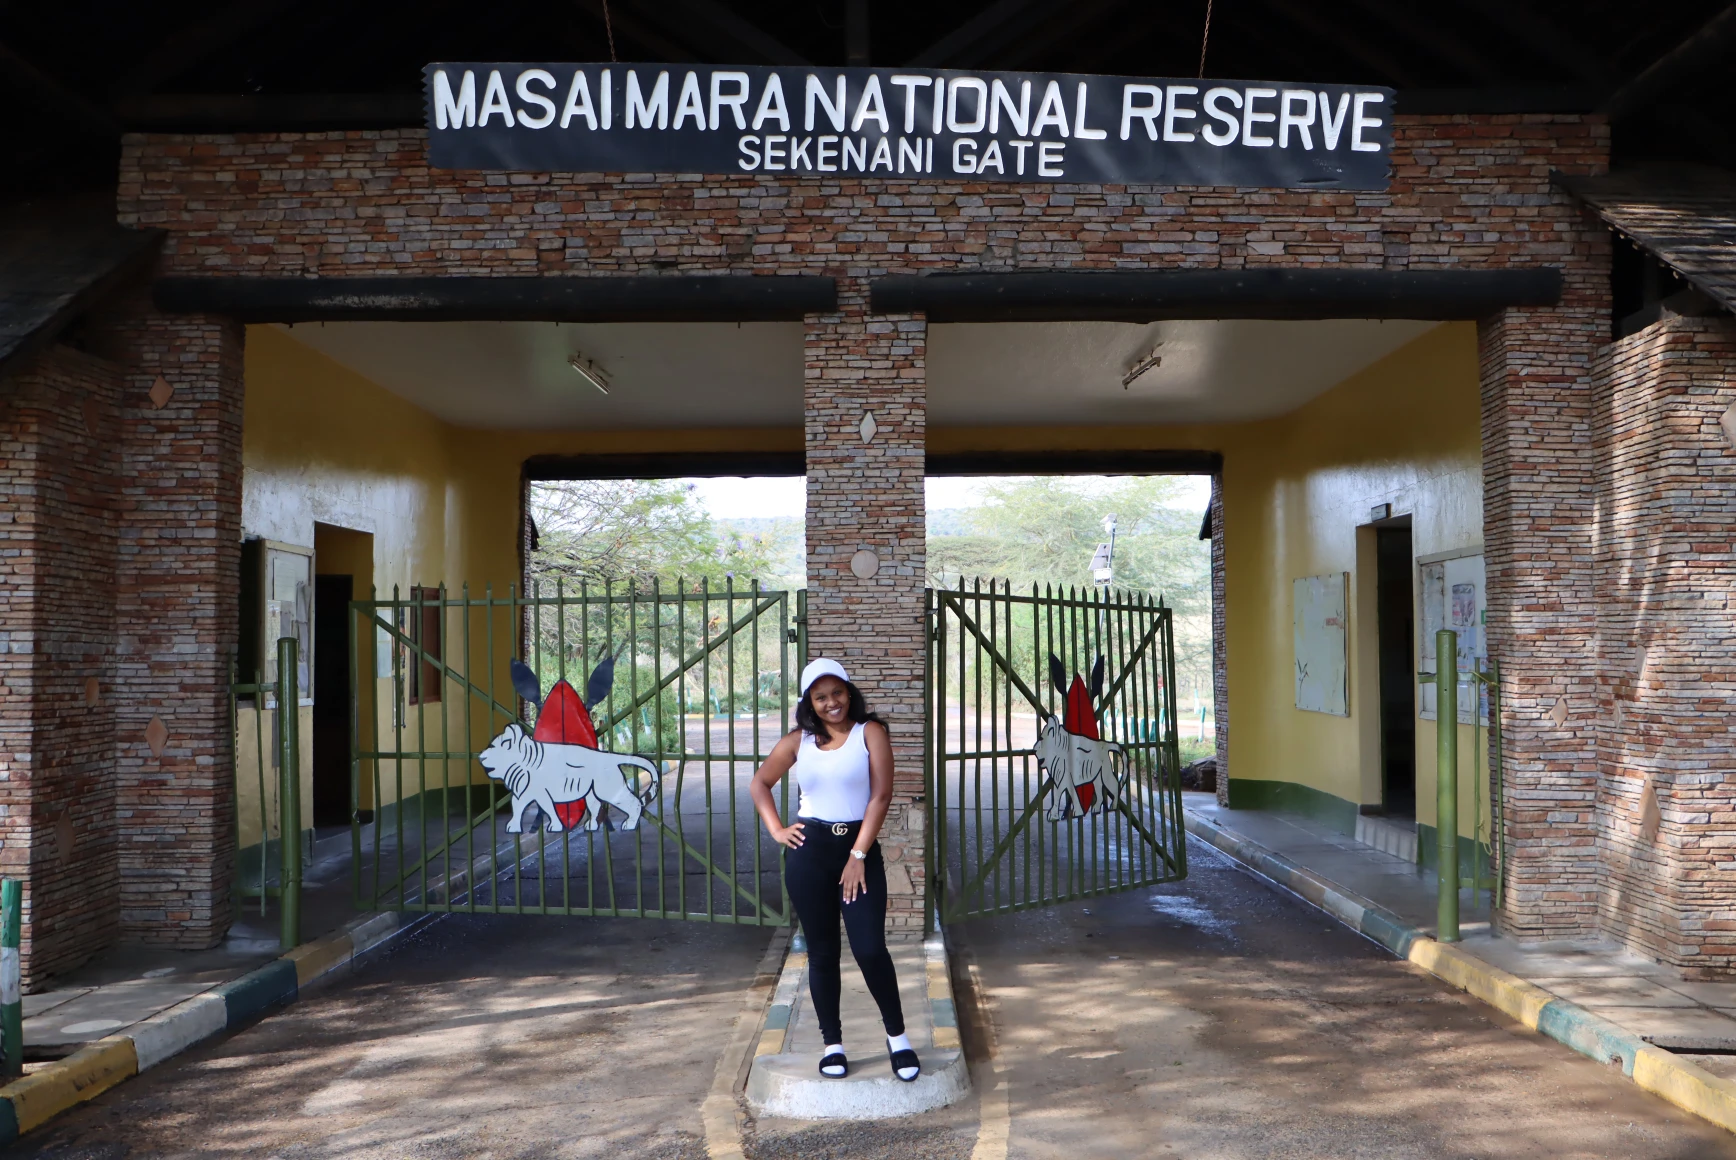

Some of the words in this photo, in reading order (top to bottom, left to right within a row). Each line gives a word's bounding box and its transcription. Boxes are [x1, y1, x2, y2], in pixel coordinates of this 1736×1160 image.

[433, 69, 612, 130] MASAI
[625, 71, 791, 131] MARA
[804, 74, 1108, 140] NATIONAL
[1119, 83, 1385, 152] RESERVE
[738, 135, 933, 174] SEKENANI
[952, 137, 1066, 177] GATE
